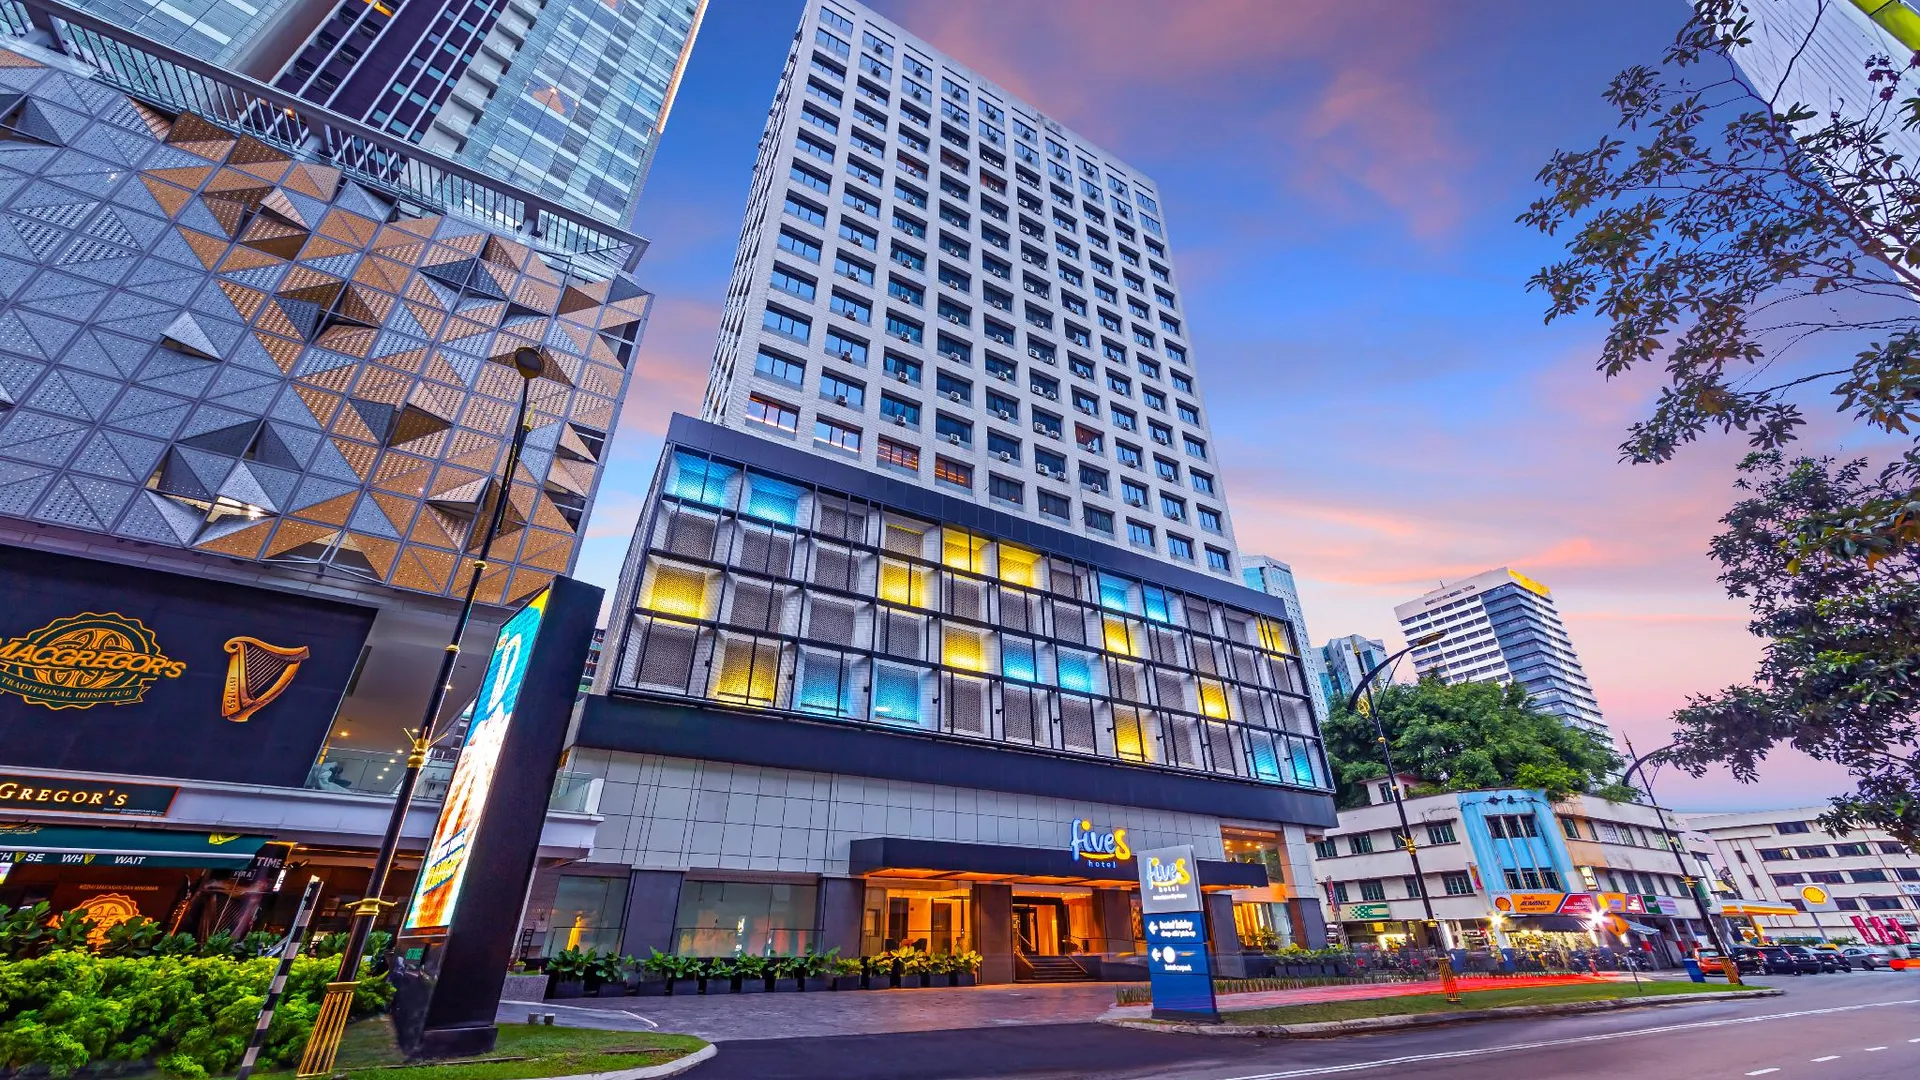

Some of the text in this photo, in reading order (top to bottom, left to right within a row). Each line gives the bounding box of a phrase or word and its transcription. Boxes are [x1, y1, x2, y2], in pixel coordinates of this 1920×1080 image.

[1, 676, 72, 698] TRADITIONAL
[110, 689, 133, 698] PUB
[114, 856, 146, 865] WAIT
[257, 857, 282, 869] TIME
[1088, 860, 1116, 868] hotel
